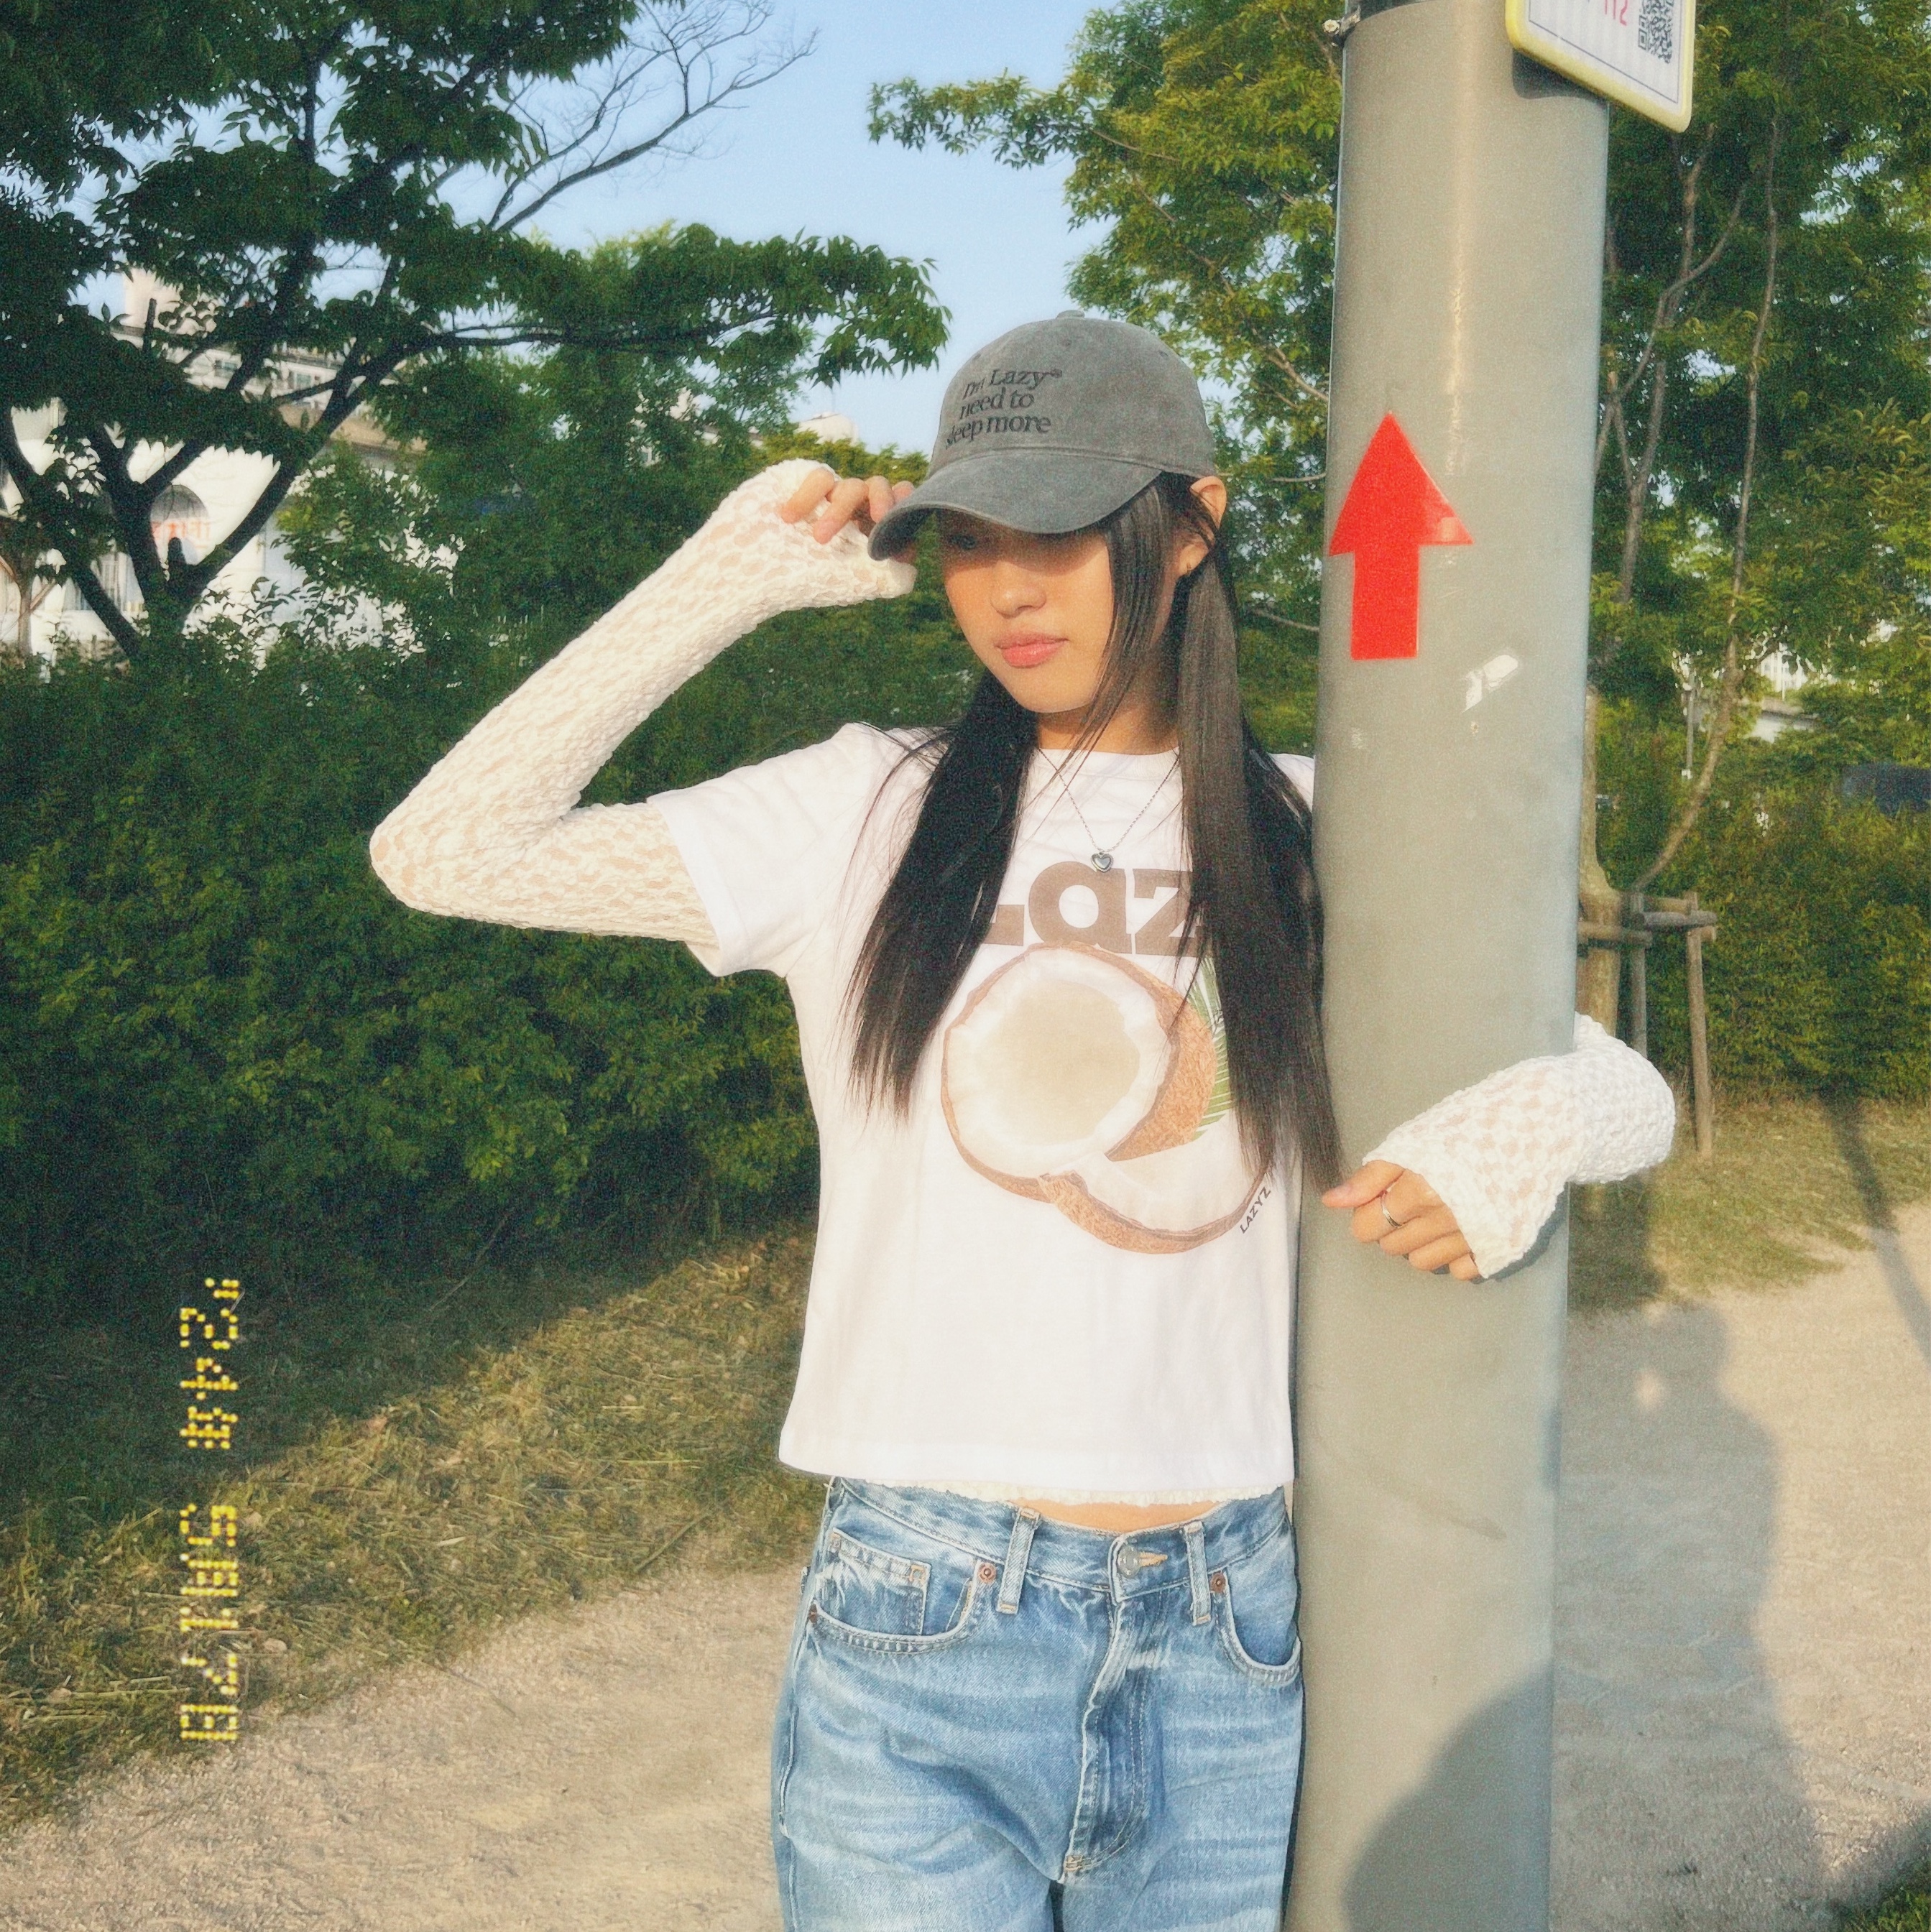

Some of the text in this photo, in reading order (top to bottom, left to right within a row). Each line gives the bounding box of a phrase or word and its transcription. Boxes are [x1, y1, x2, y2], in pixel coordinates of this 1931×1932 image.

[959, 387, 1035, 420] need to
[985, 415, 1052, 434] more
[1240, 1186, 1271, 1234] LAZYZ
